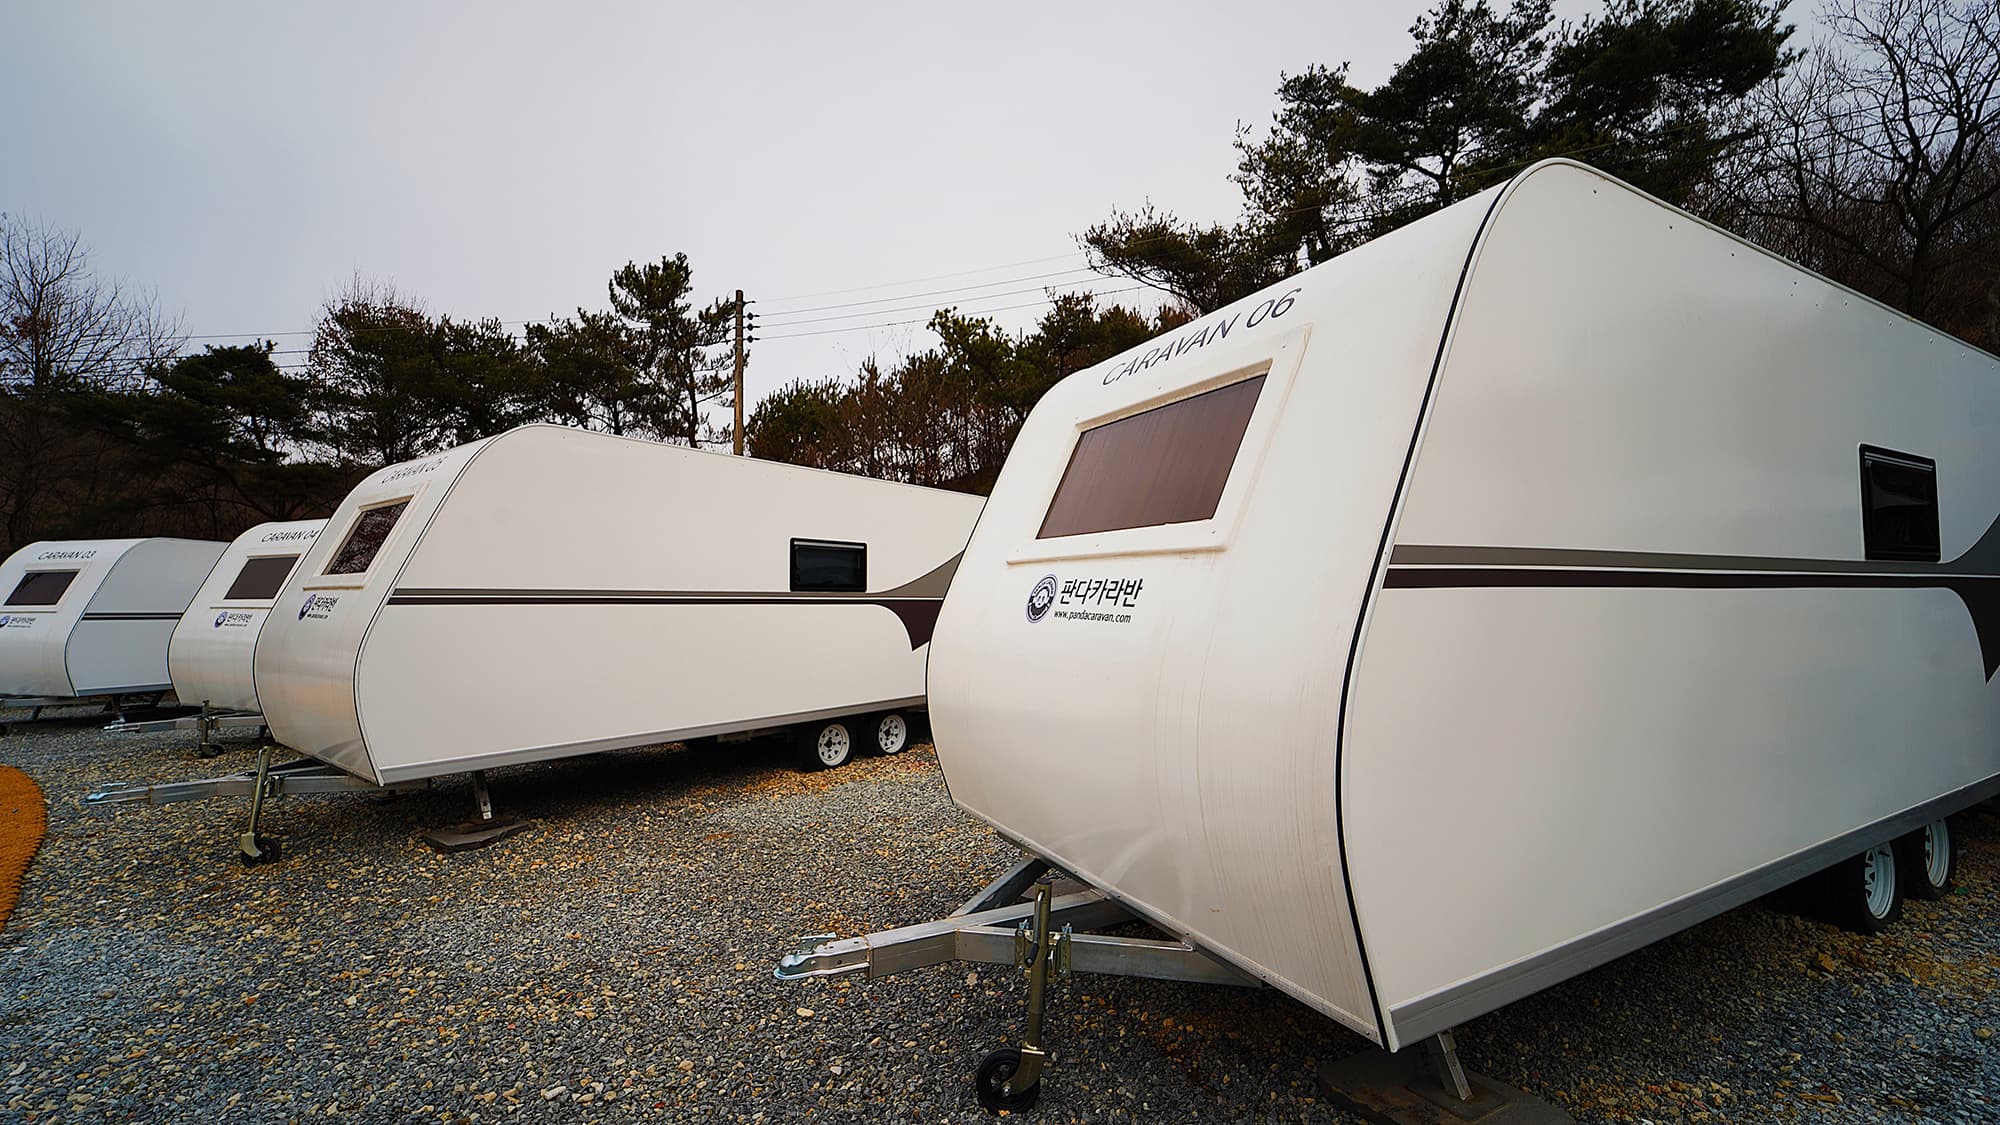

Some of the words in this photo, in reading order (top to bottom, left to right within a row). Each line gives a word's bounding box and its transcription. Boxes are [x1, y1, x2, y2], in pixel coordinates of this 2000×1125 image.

[1102, 312, 1240, 387] CARAVAN
[1245, 287, 1302, 329] 06
[261, 530, 307, 543] CARAVAN
[38, 551, 82, 560] CARAVAN
[1059, 578, 1144, 608] 판다카라반
[1053, 610, 1132, 624] www.pandacaravan.com
